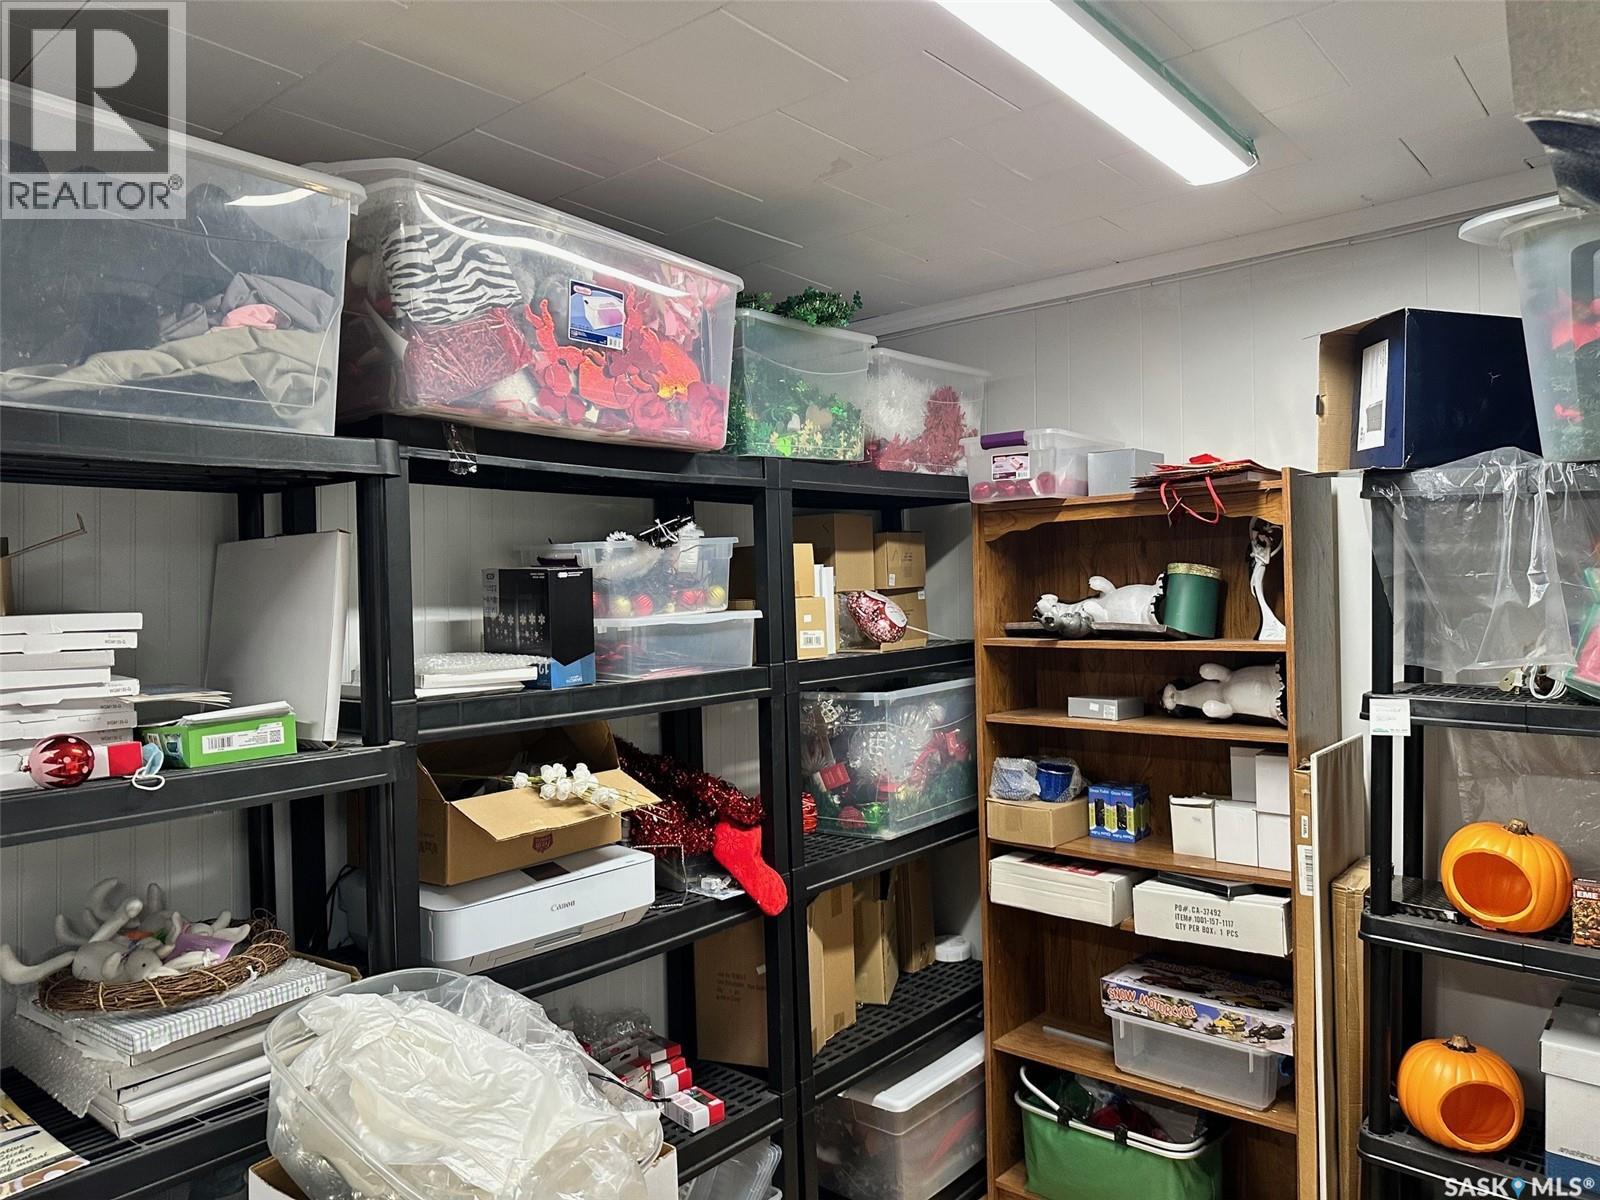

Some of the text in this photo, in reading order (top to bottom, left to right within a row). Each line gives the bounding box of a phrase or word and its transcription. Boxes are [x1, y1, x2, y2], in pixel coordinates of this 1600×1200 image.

[550, 900, 576, 912] Canon
[1175, 922, 1186, 931] QTY
[1188, 924, 1200, 933] PER
[1226, 929, 1239, 938] PCS
[1107, 987, 1198, 1019] SNOW MOTORCYCLE
